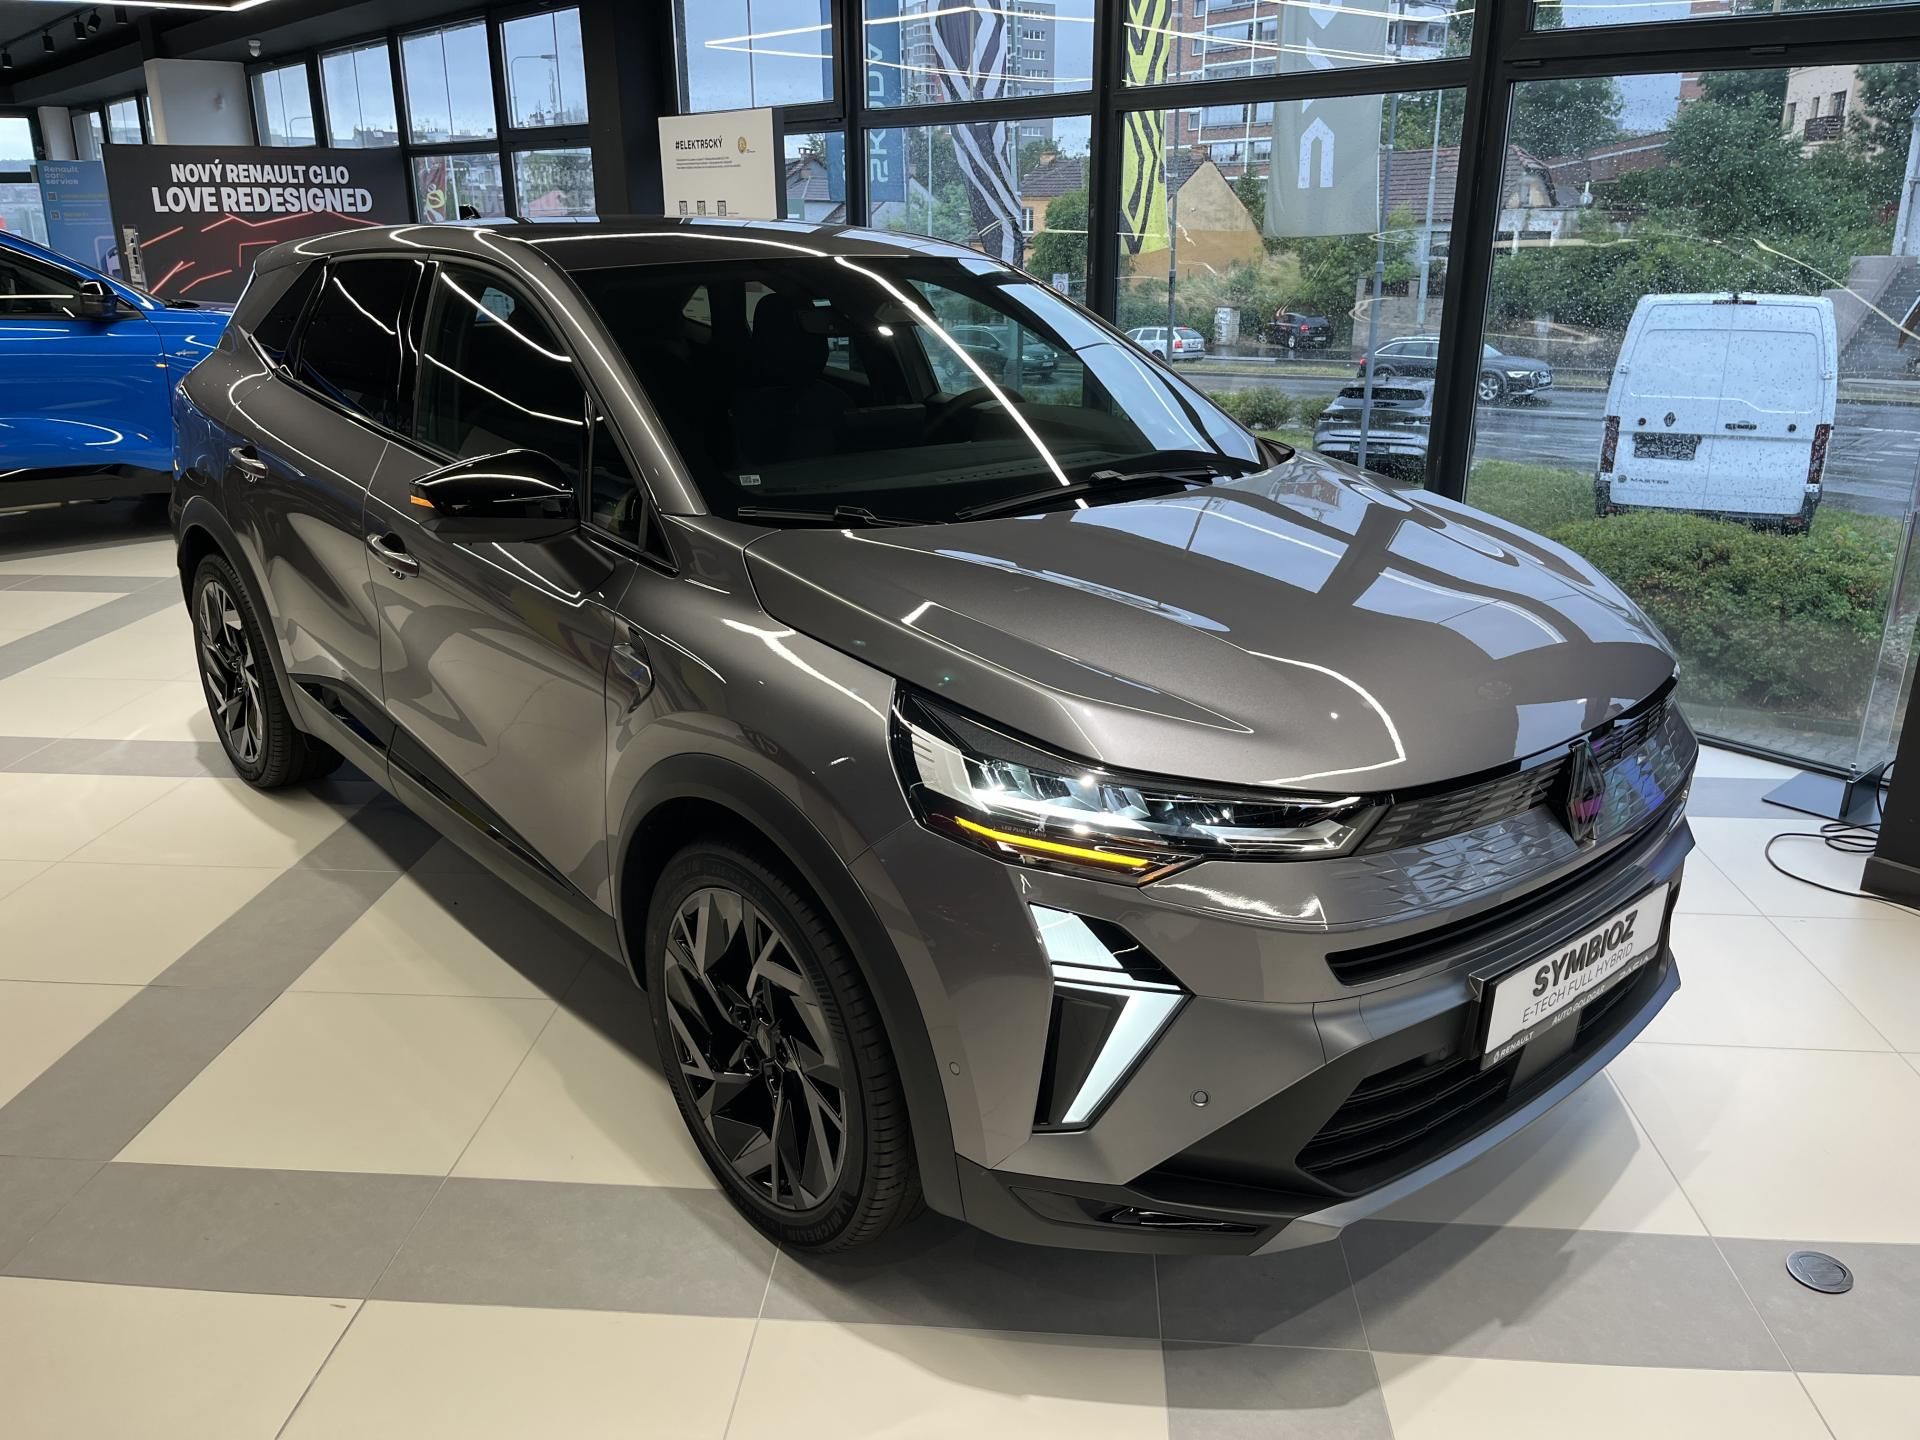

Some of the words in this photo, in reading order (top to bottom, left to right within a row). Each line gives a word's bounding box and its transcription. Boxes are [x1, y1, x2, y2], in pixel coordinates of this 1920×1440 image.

[675, 136, 723, 150] #ELEKTR5CKÝ
[43, 165, 79, 173] Renault
[170, 158, 223, 183] NOVÝ
[226, 164, 306, 184] RENAULT
[309, 165, 349, 185] CLIO
[151, 186, 219, 213] LOVE
[220, 187, 373, 213] REDESIGNED
[1532, 909, 1639, 997] SYMBIOZ
[1522, 988, 1566, 1024] E-TECH
[1567, 973, 1593, 996] FULL
[1594, 942, 1633, 979] HYBRID
[1551, 1004, 1574, 1025] AUTO
[1500, 1031, 1534, 1057] RENAULT
